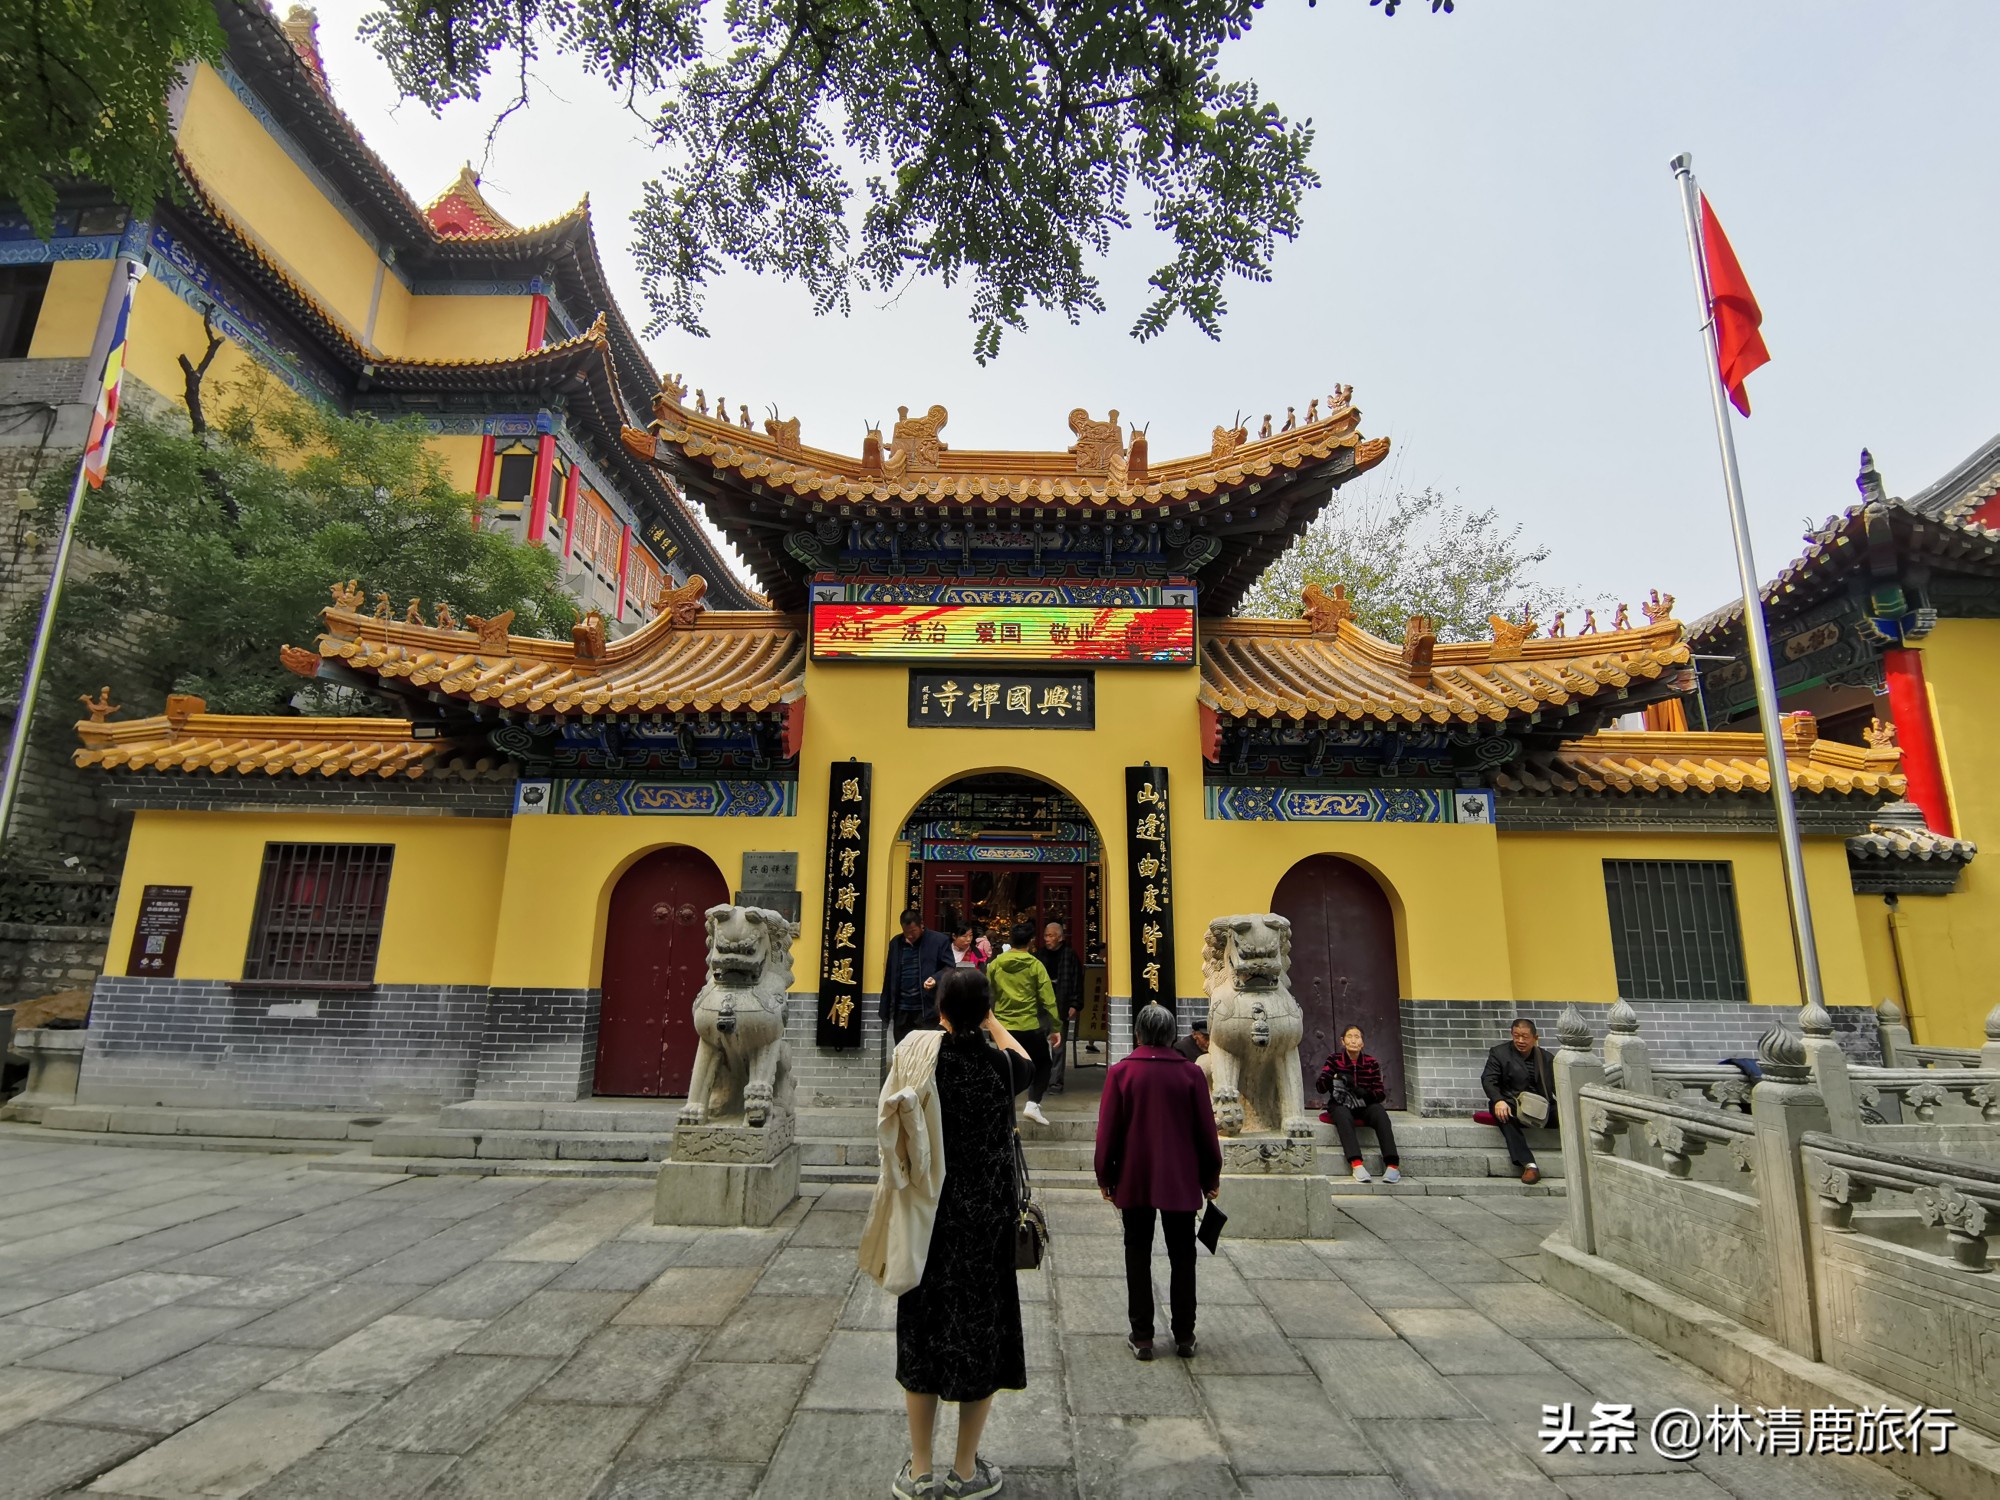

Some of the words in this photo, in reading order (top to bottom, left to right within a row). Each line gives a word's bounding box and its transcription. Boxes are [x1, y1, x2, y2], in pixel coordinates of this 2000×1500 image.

[828, 620, 874, 642] 公正
[902, 621, 948, 643] 法治
[975, 621, 1022, 644] 爱国
[1049, 623, 1096, 645] 敬业
[1136, 782, 1164, 1008] 山逢曲處皆有
